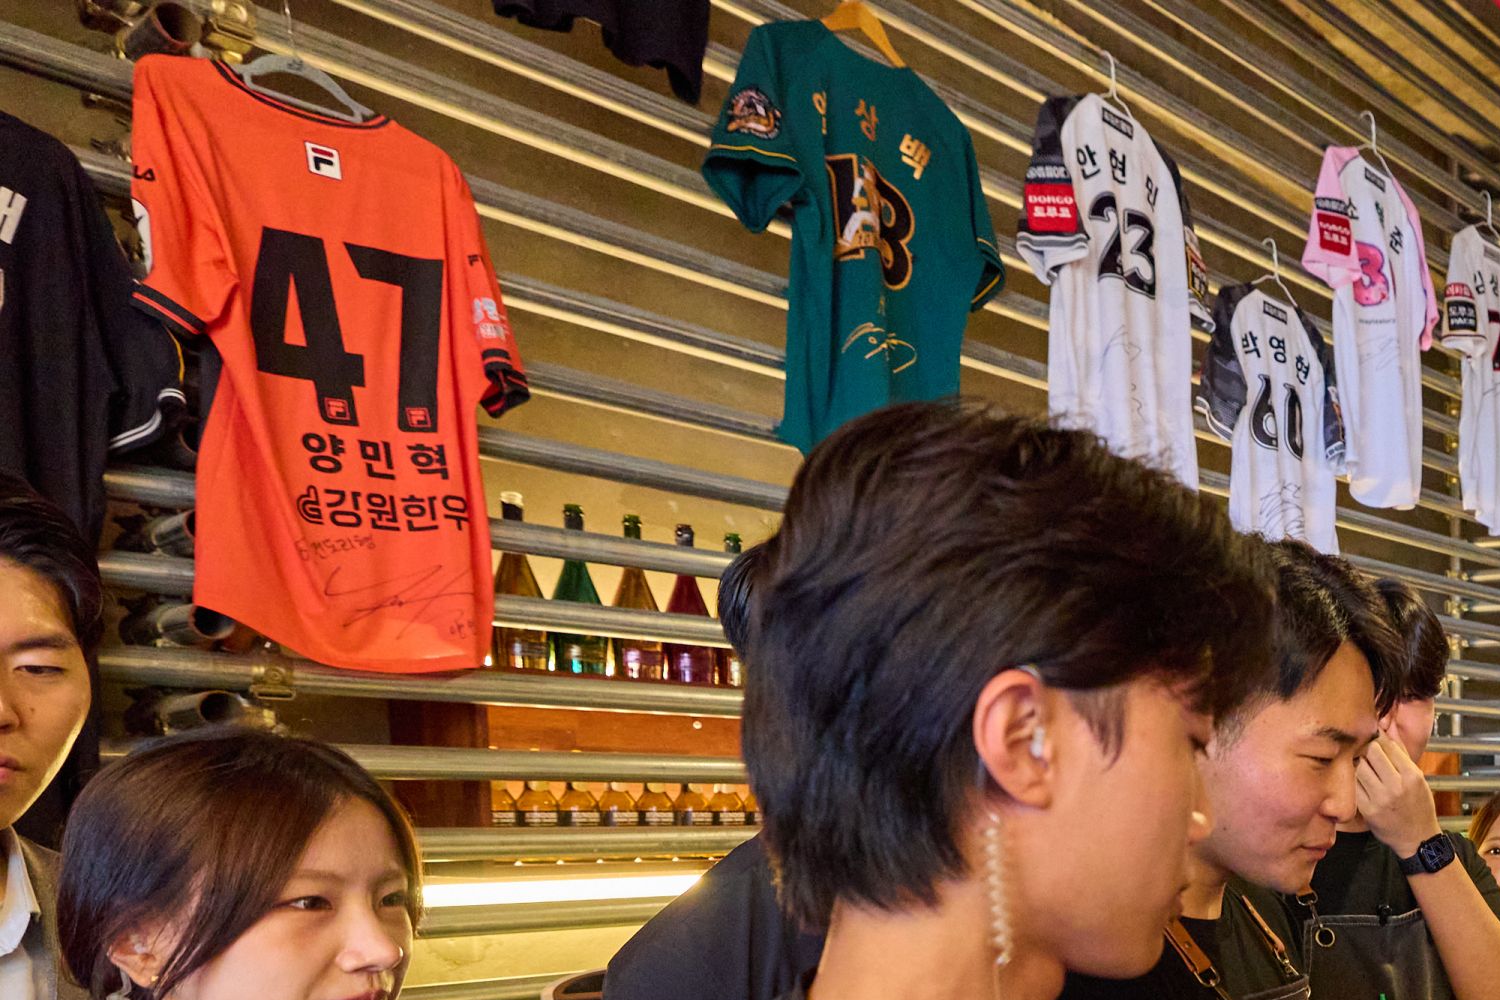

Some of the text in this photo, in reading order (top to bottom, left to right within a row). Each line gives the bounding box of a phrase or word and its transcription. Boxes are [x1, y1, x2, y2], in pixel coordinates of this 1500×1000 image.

[1076, 144, 1159, 213] 안현민
[1088, 191, 1157, 301] 23
[250, 225, 445, 433] 47
[1242, 331, 1310, 385] 박영현
[1251, 373, 1304, 461] 60
[302, 432, 449, 480] 양민혁
[323, 488, 470, 532] 강원한우
